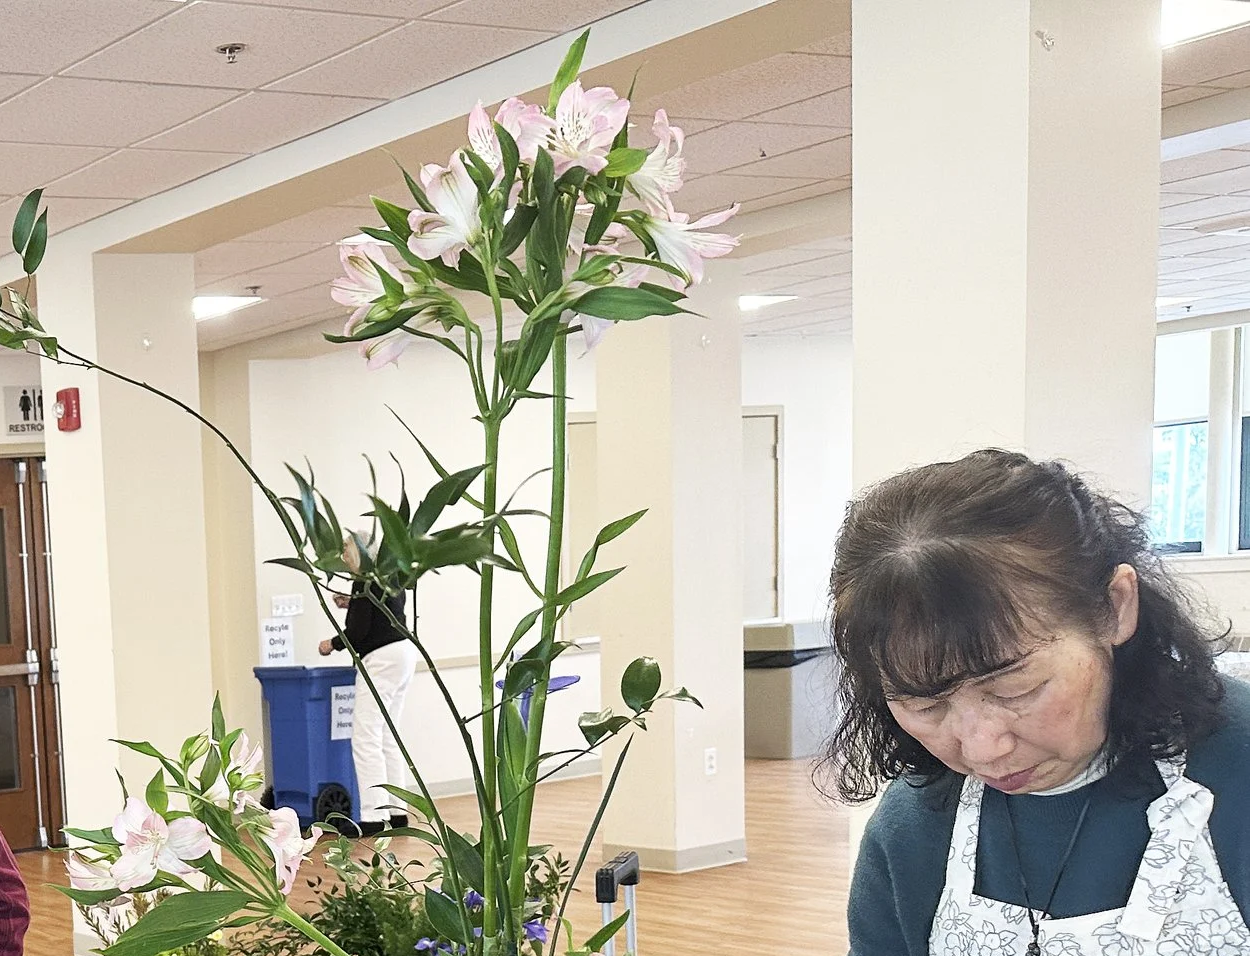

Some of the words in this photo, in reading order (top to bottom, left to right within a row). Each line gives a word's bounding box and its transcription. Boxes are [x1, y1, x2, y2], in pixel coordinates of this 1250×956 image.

[8, 423, 45, 433] RESTRO
[269, 637, 286, 646] Only
[268, 651, 288, 660] Here!
